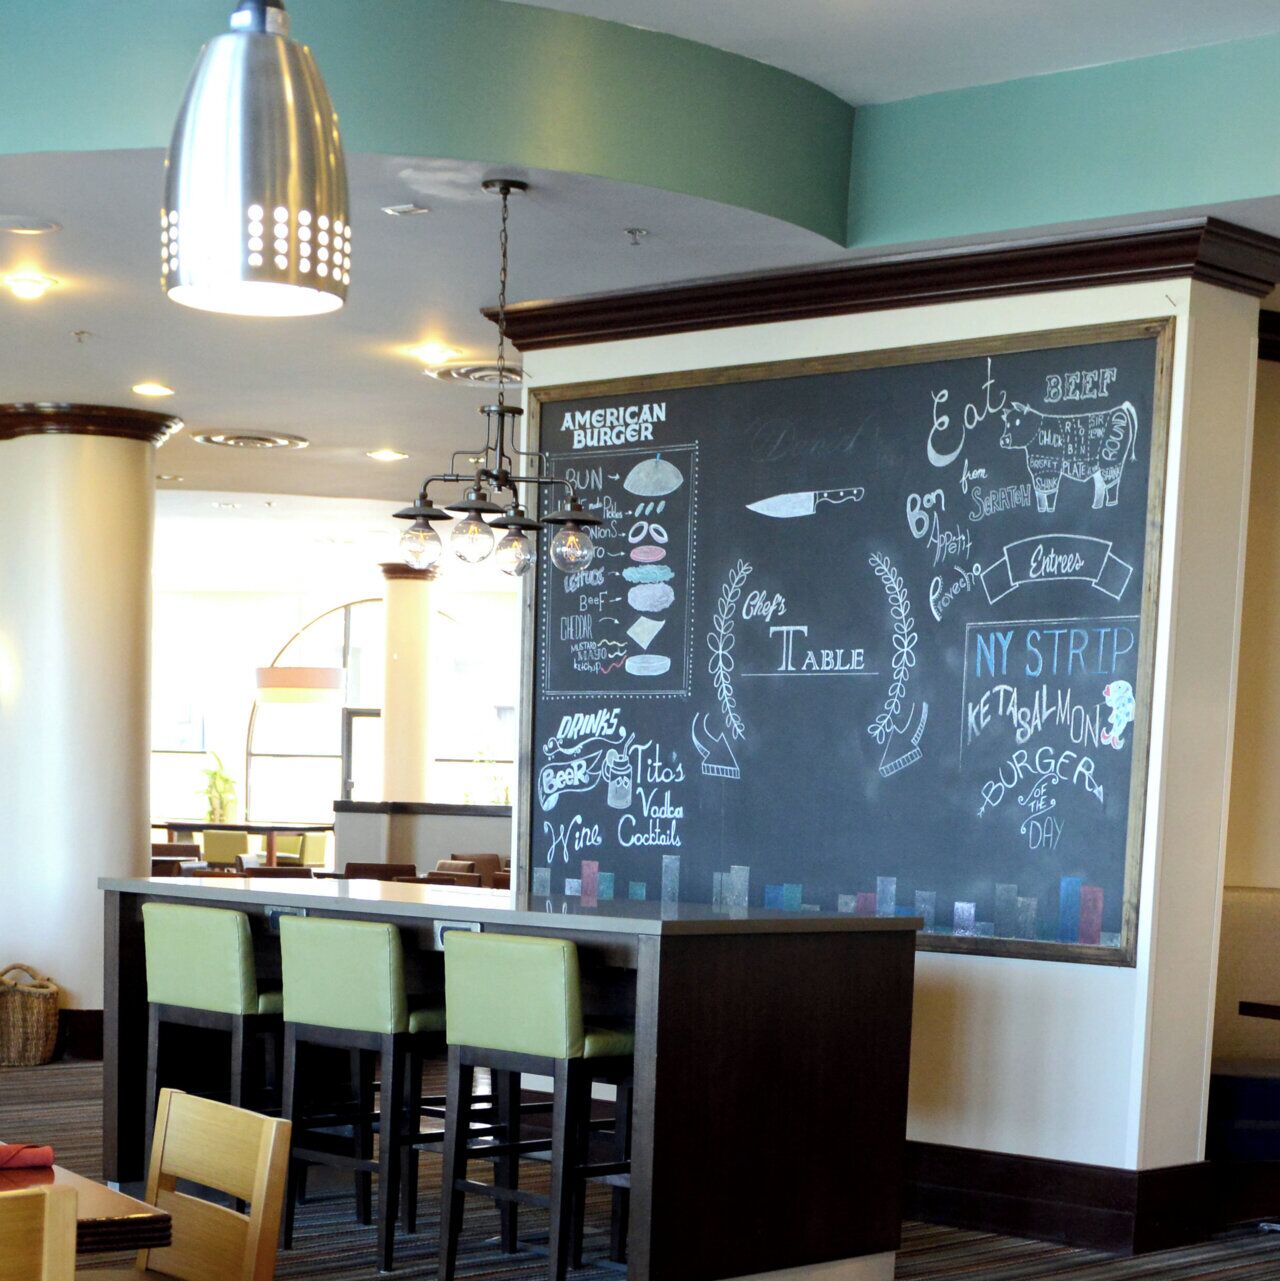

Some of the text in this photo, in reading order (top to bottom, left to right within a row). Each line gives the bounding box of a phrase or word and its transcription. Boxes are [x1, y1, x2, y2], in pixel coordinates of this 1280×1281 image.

[1044, 367, 1117, 403] BEEF
[560, 402, 667, 432] AMERICAN
[927, 356, 1007, 468] Eat
[572, 422, 654, 449] BURGER
[1038, 429, 1063, 449] CHUCK
[1101, 411, 1128, 461] ROUND
[959, 458, 988, 494] from
[1029, 457, 1058, 469] BRISKET
[1062, 461, 1086, 479] PLATE
[564, 466, 603, 496] BUN
[906, 488, 946, 539] Bon
[1029, 544, 1084, 578] Entrees
[742, 589, 787, 622] Chef's
[560, 614, 593, 641] CHEDDAR
[570, 641, 597, 653] MUSTARD
[976, 627, 1134, 678] NY STRIP
[556, 707, 621, 740] DRINKS
[968, 684, 1100, 748] KETA SALMON
[629, 739, 686, 784] Tito's
[980, 746, 1095, 807] BURGER
[635, 787, 684, 819] Vodka
[1028, 797, 1047, 812] THE
[1033, 783, 1047, 797] OF
[543, 814, 603, 864] Wine
[618, 814, 682, 847] Cocktails
[1028, 816, 1064, 849] DAY
